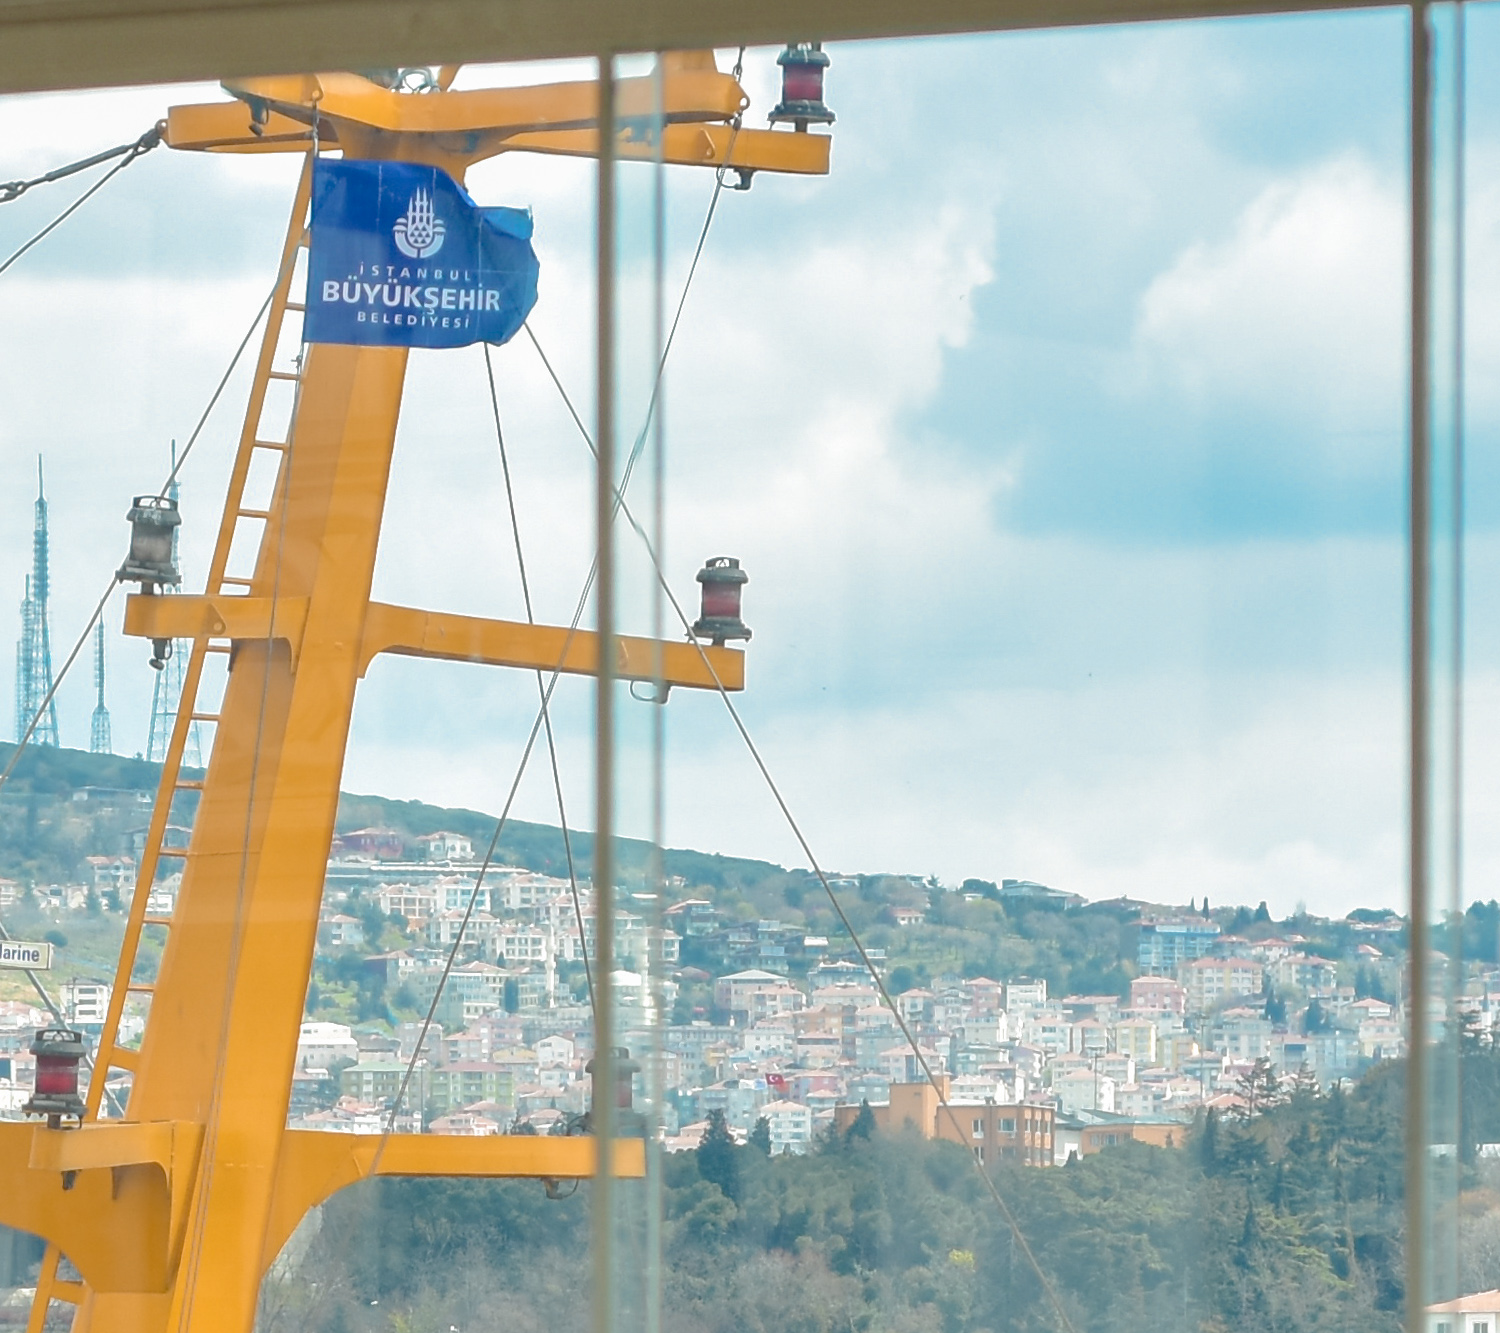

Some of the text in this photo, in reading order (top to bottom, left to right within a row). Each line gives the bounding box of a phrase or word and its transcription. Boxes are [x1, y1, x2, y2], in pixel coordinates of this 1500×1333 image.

[359, 261, 471, 281] İSTANBUL
[322, 275, 501, 315] BÜYÜKŞEHİR
[356, 312, 471, 329] BELEDİYESİ
